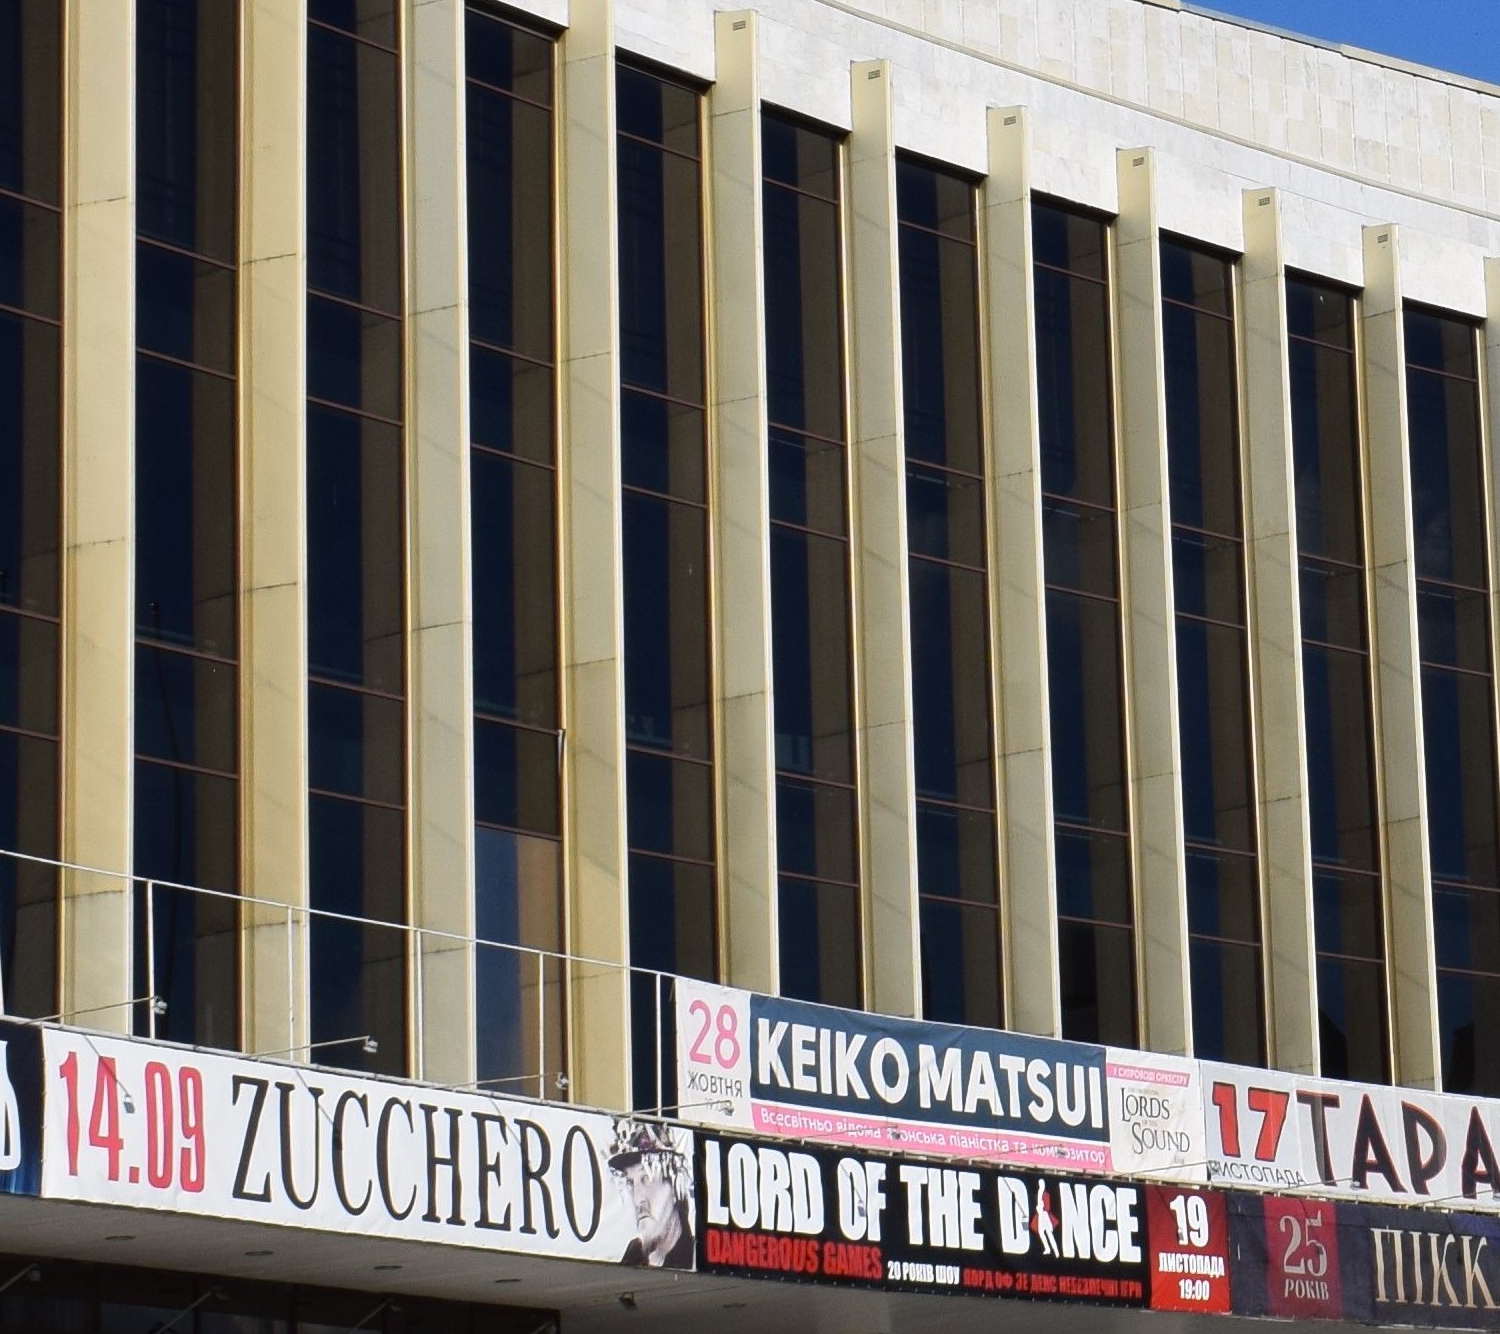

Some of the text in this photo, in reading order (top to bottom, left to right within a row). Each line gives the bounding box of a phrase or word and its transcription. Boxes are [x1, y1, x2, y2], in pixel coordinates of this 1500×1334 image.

[688, 999, 741, 1069] 28
[687, 1070, 743, 1099] ЖОВТНЯ
[757, 1017, 1104, 1129] KEIKO MATSUI
[59, 1051, 602, 1243] 14.09 ZUCCHERO
[760, 1107, 833, 1132] Всесвітньо
[949, 1130, 1009, 1152] піаністка
[1013, 1141, 1029, 1154] та
[1212, 1080, 1290, 1163] 17
[704, 1140, 825, 1235] LORD
[837, 1157, 887, 1242] OF
[900, 1165, 984, 1250] THE
[1169, 1194, 1209, 1247] 19
[707, 1229, 884, 1280] DANGEROUS GAMES
[1158, 1252, 1225, 1278] ЛИСТОПАДА
[1279, 1210, 1328, 1276] 25
[887, 1260, 960, 1285] 20 РОКІВ ШОУ
[1178, 1278, 1210, 1301] 19:00
[1284, 1277, 1329, 1300] РОКІВ
